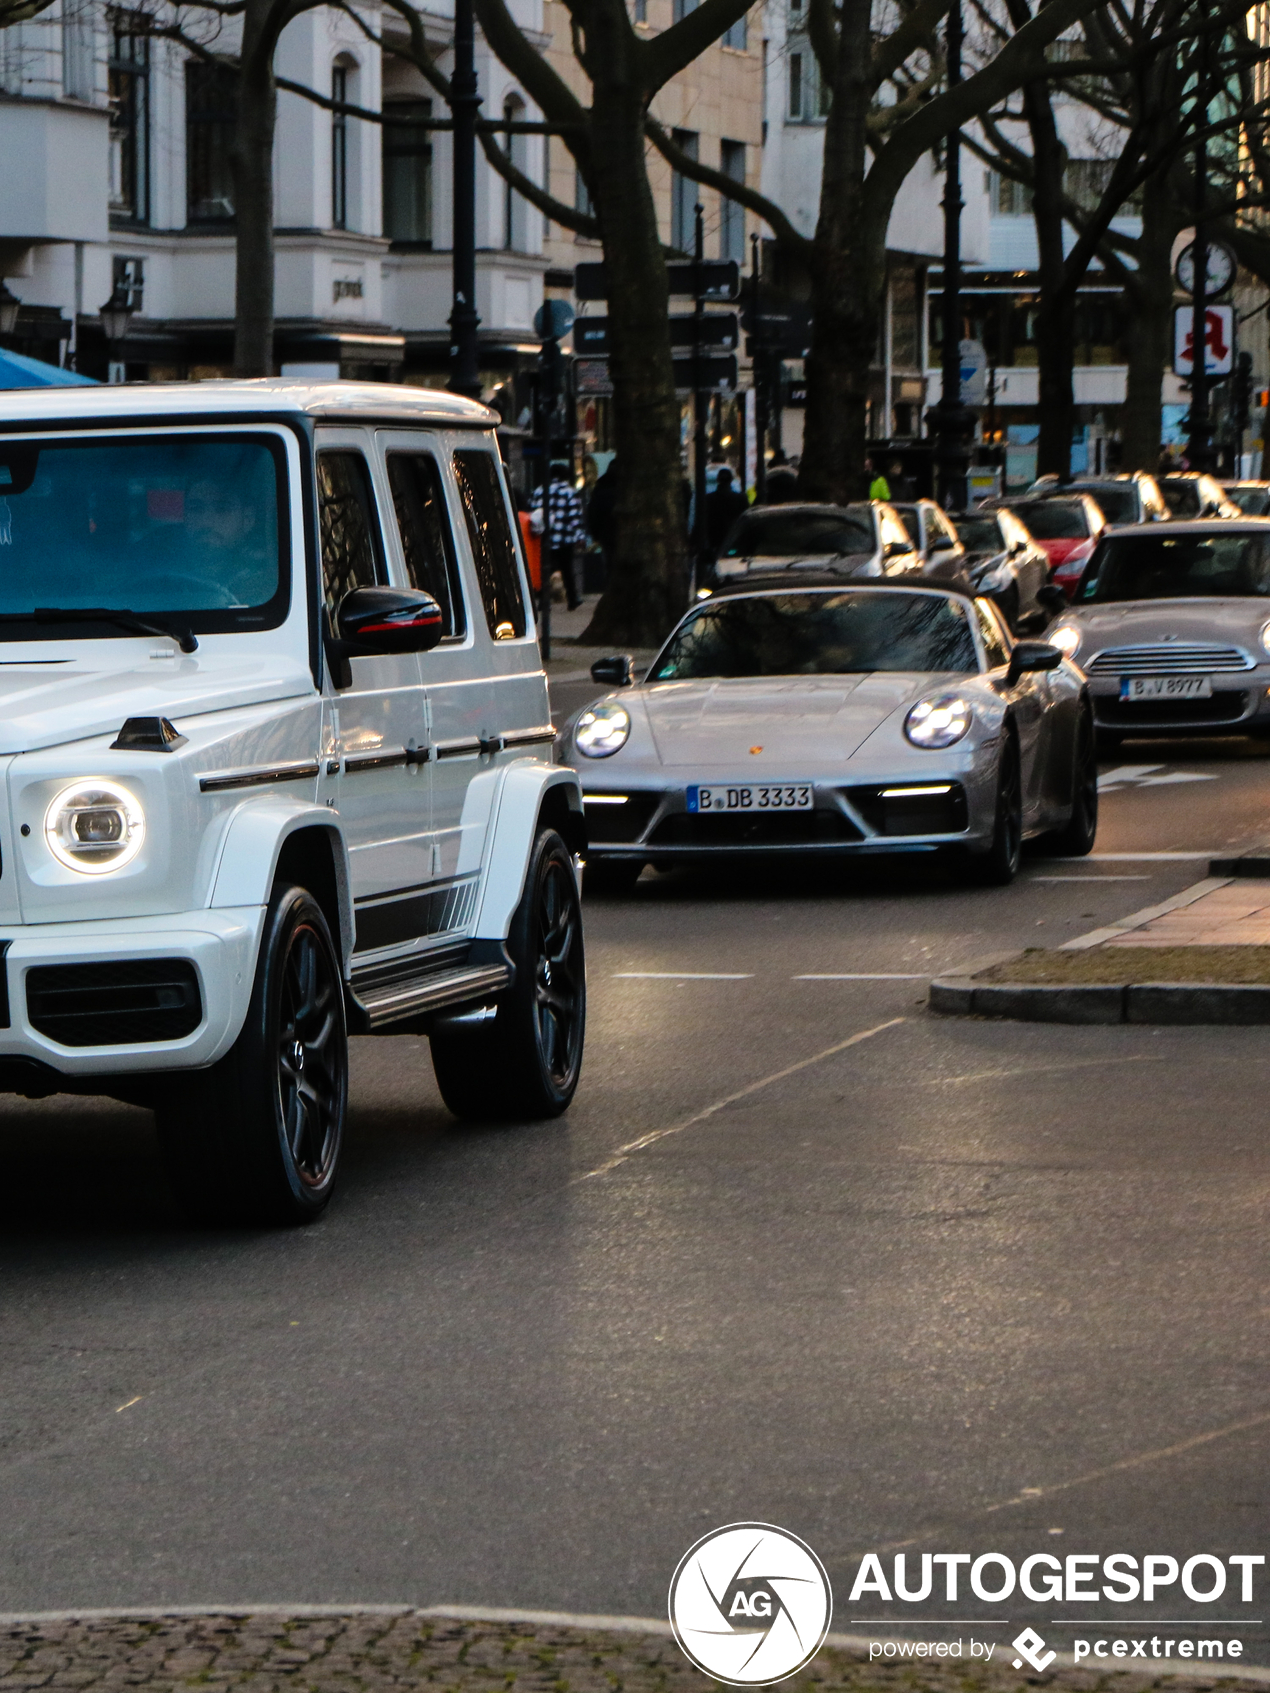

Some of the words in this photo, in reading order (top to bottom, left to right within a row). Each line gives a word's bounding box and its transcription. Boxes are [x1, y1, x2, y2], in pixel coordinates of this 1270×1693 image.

[699, 789, 712, 809] B
[727, 788, 753, 808] DB
[758, 787, 810, 808] 3333
